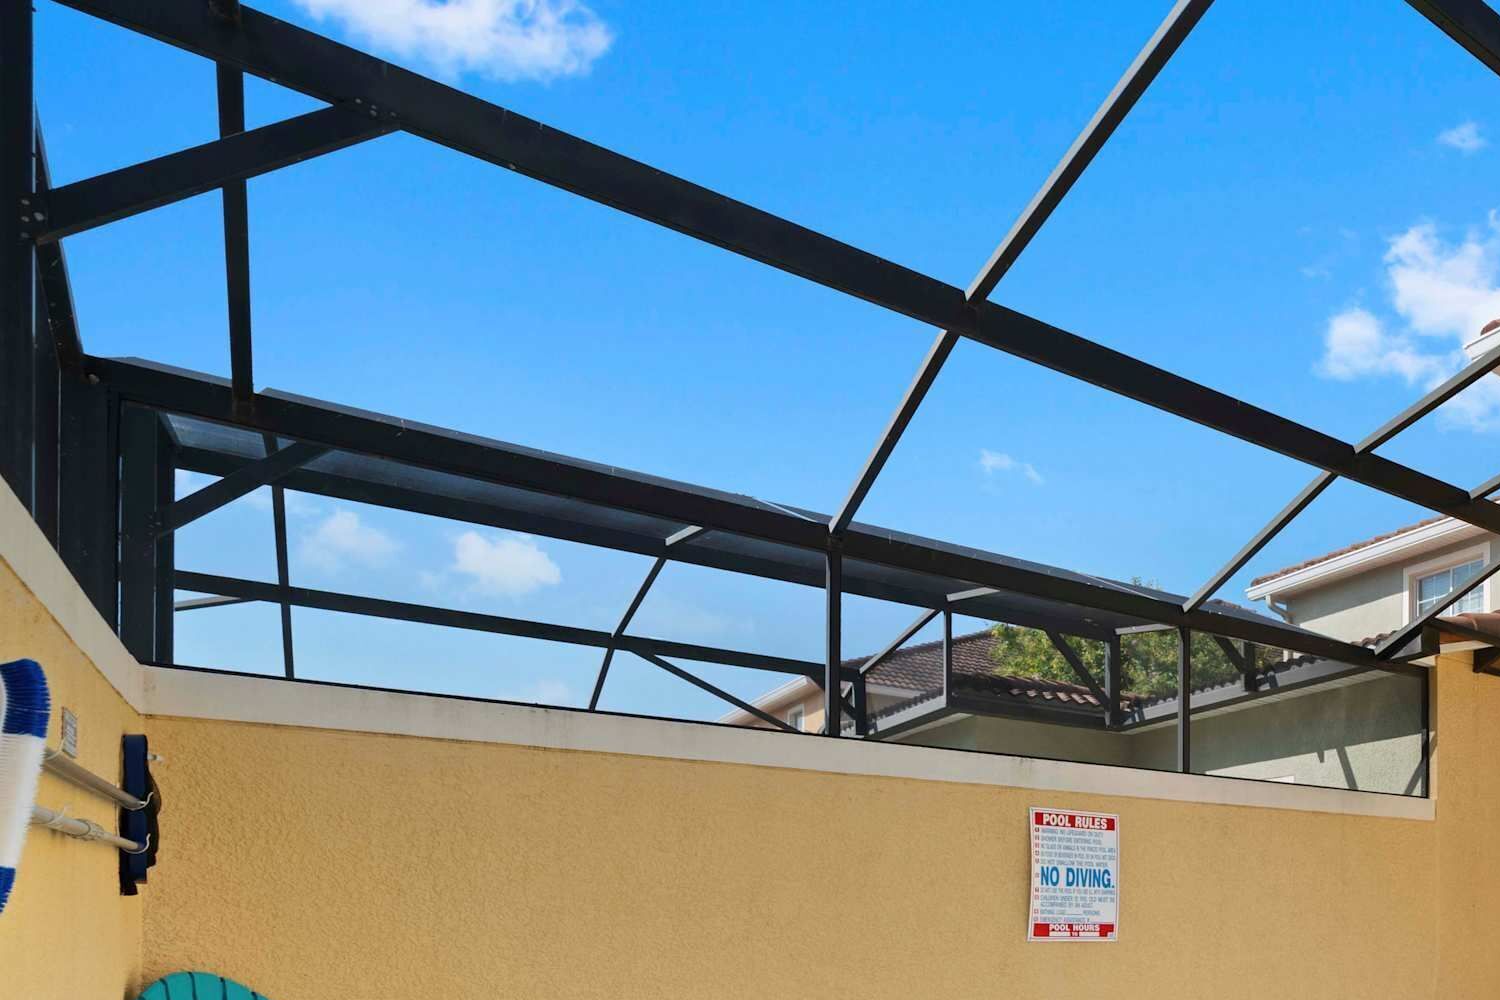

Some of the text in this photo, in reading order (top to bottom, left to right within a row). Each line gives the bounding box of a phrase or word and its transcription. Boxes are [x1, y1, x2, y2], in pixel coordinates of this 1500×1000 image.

[1043, 814, 1107, 829] POOL RULES
[1041, 866, 1115, 888] NO DIVING.
